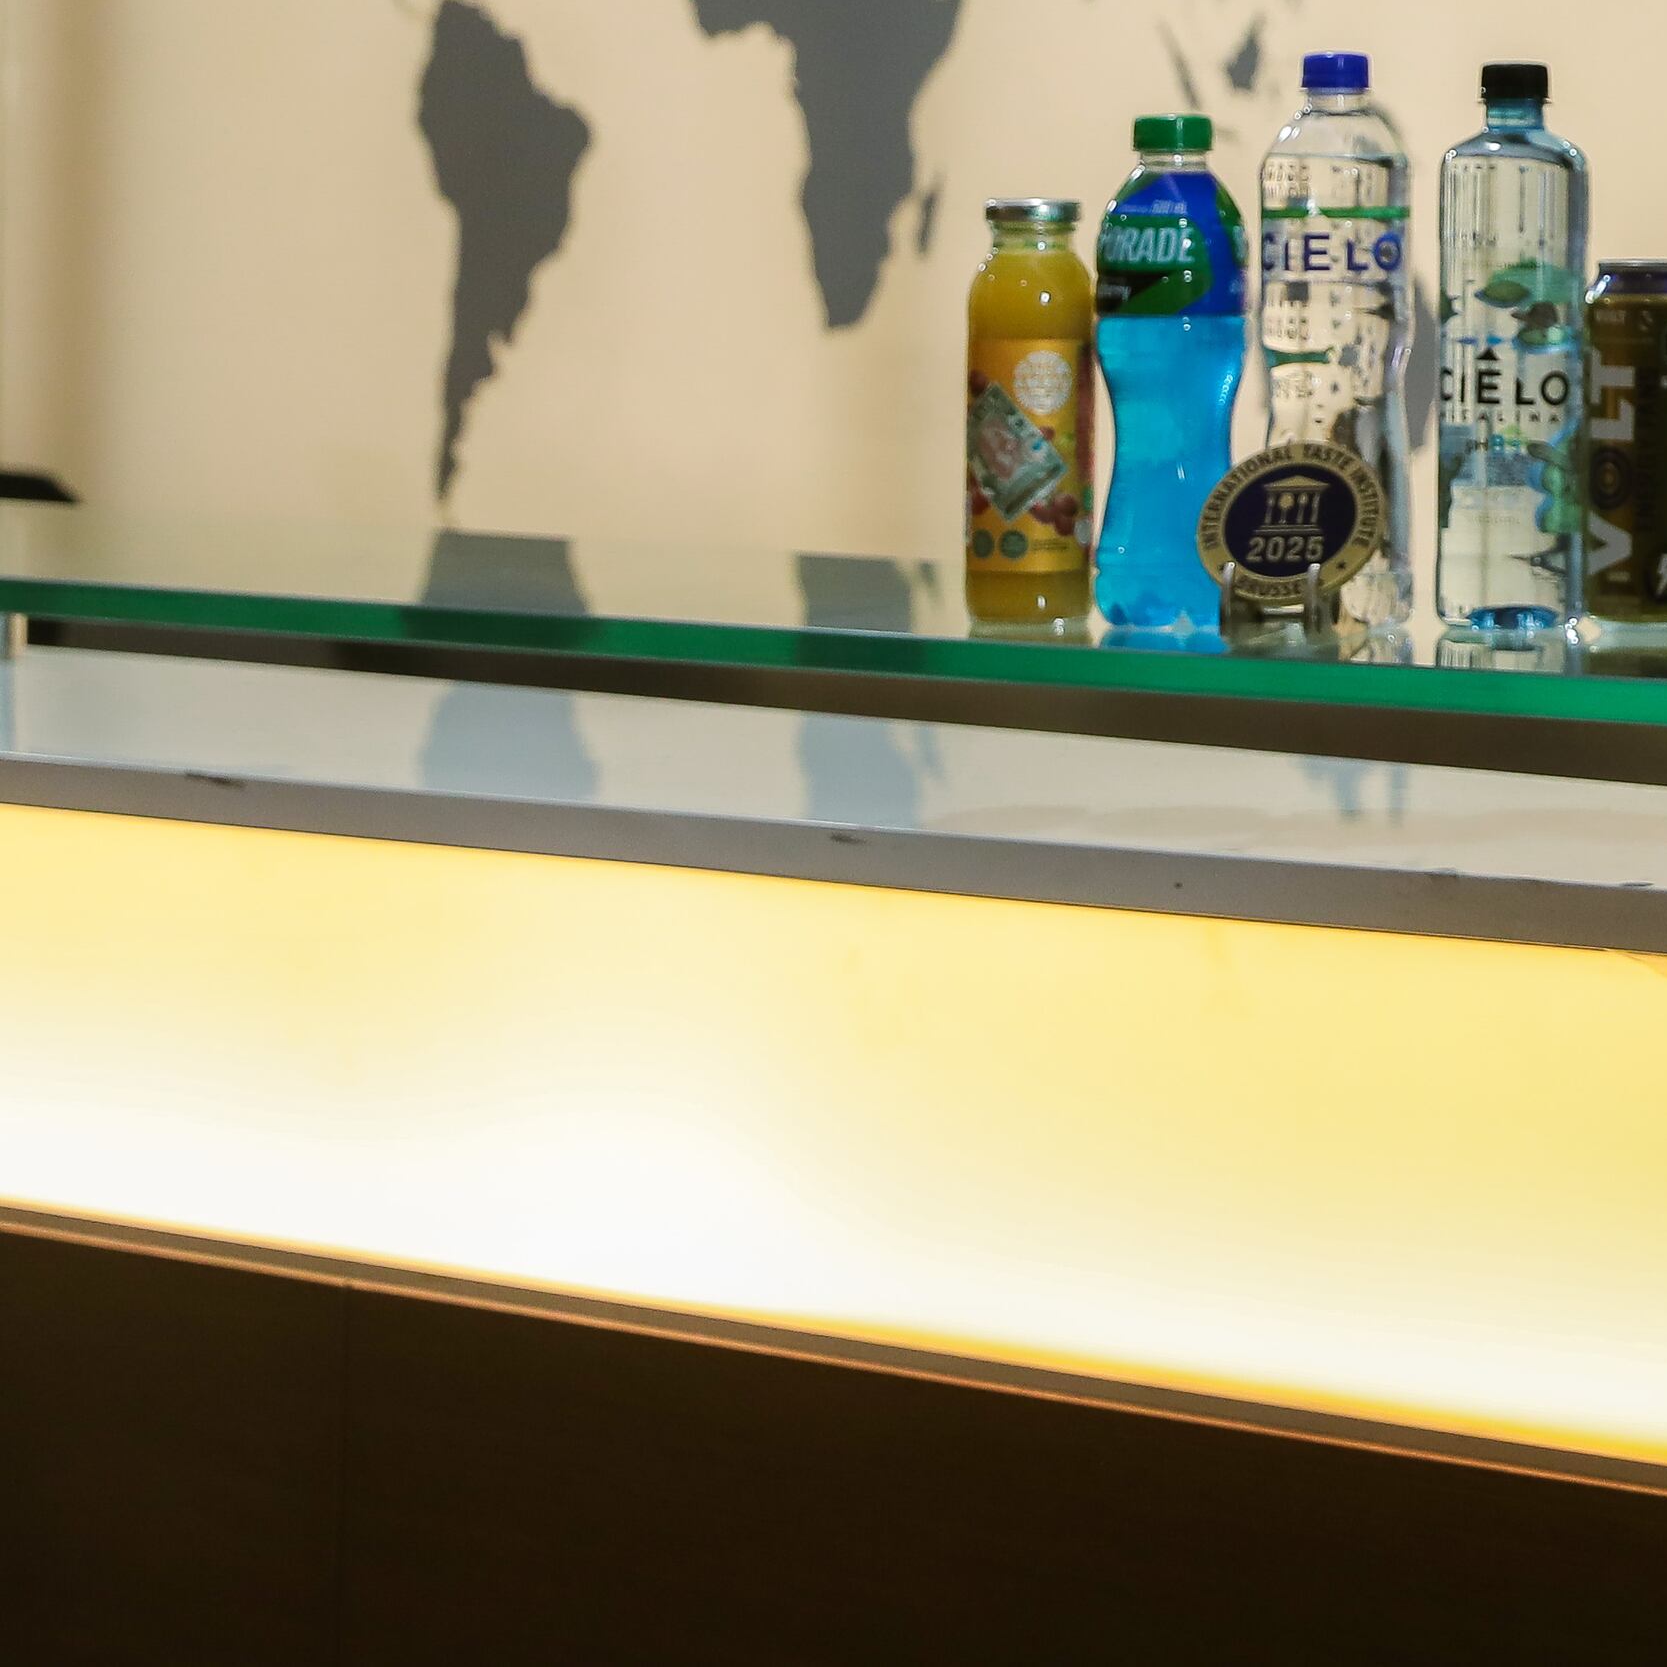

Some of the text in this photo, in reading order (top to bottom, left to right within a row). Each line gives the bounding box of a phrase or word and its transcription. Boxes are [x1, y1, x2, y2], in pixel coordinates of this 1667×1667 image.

[1100, 226, 1195, 264] ORADE
[1262, 232, 1401, 272] CIELO
[1440, 368, 1570, 406] CIELO
[1587, 346, 1636, 576] VOLT
[1201, 445, 1379, 549] INTERNATIONAL TASTE INSTITUTE
[1246, 535, 1325, 563] 2025
